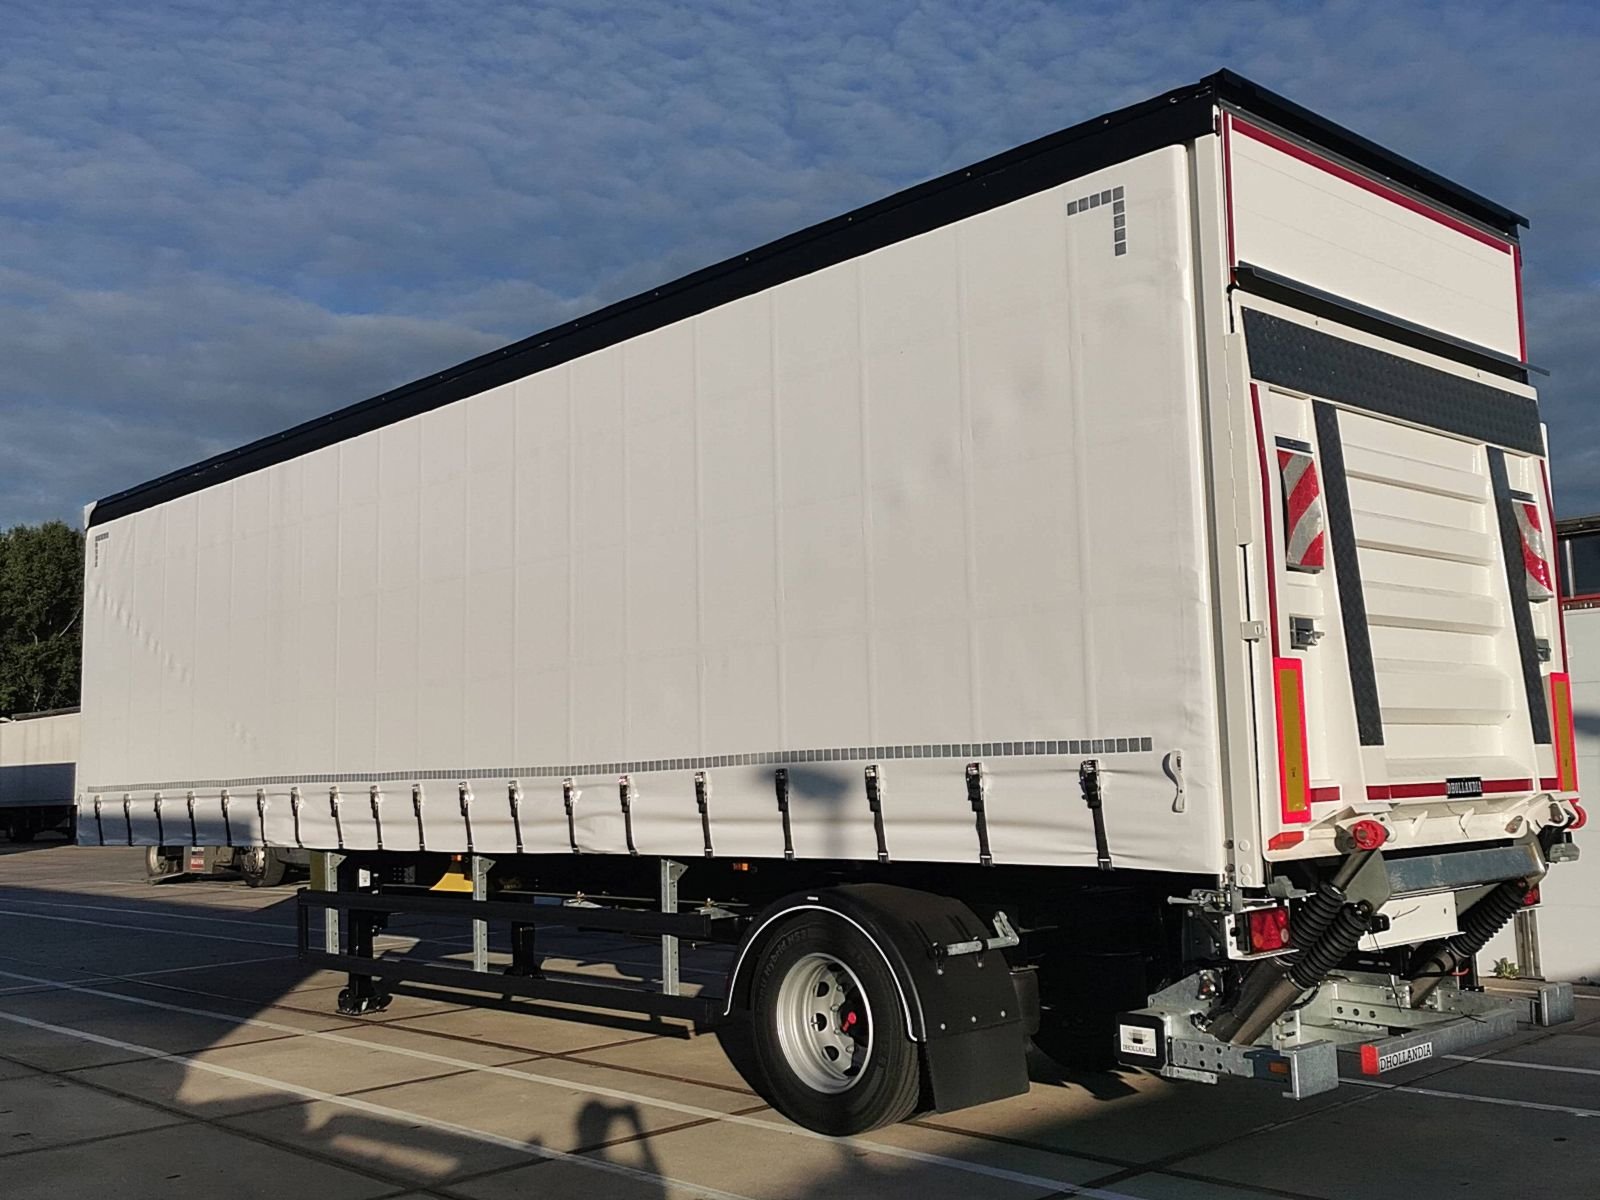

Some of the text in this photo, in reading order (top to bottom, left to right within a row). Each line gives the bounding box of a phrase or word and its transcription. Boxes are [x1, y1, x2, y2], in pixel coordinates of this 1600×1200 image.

[1447, 781, 1482, 794] DHOLLANDIA
[1122, 1044, 1156, 1055] DHOLLANDIA
[1380, 1044, 1432, 1070] DHOLLANDIA
